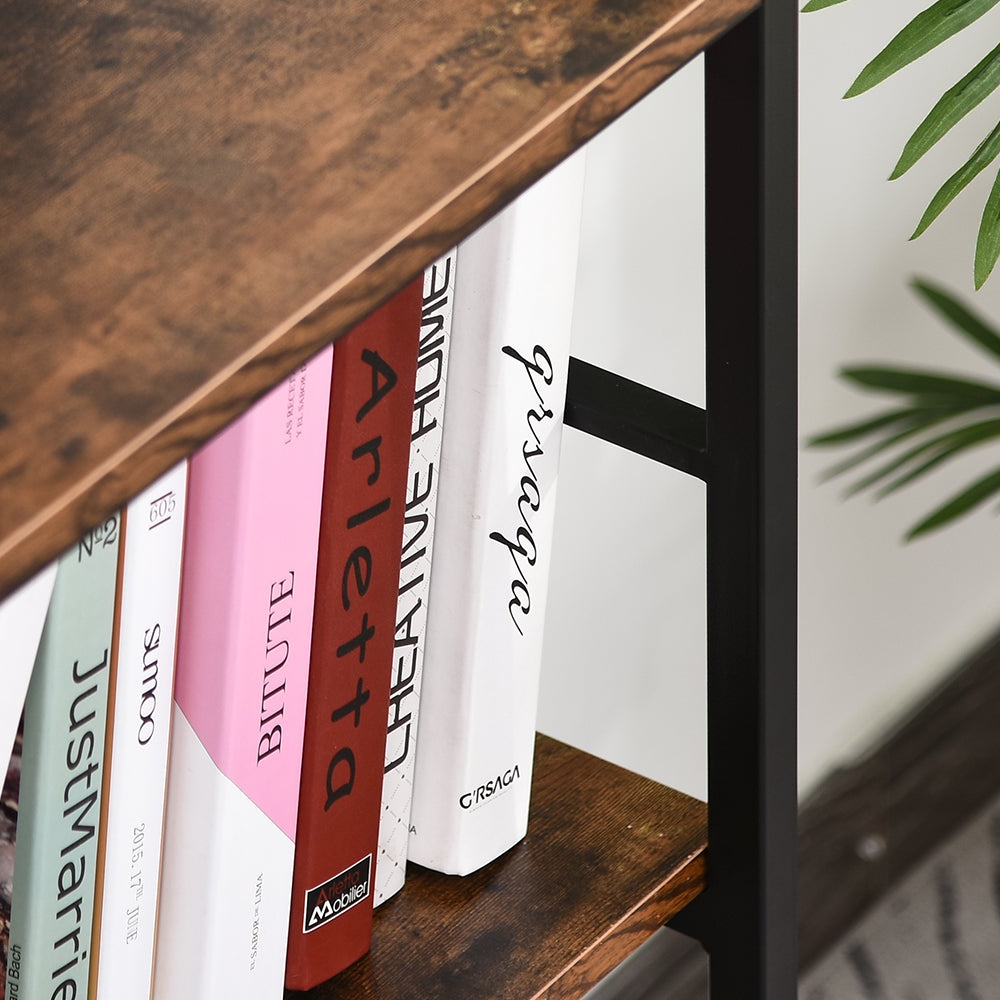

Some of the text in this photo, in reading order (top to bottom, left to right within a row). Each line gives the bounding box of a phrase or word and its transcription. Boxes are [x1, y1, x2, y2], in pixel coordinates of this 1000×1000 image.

[149, 492, 176, 523] 605
[324, 348, 398, 812] Arletta
[256, 571, 295, 766] BITUTE
[308, 881, 367, 926] Mobilier
[8, 944, 21, 980] Bach
